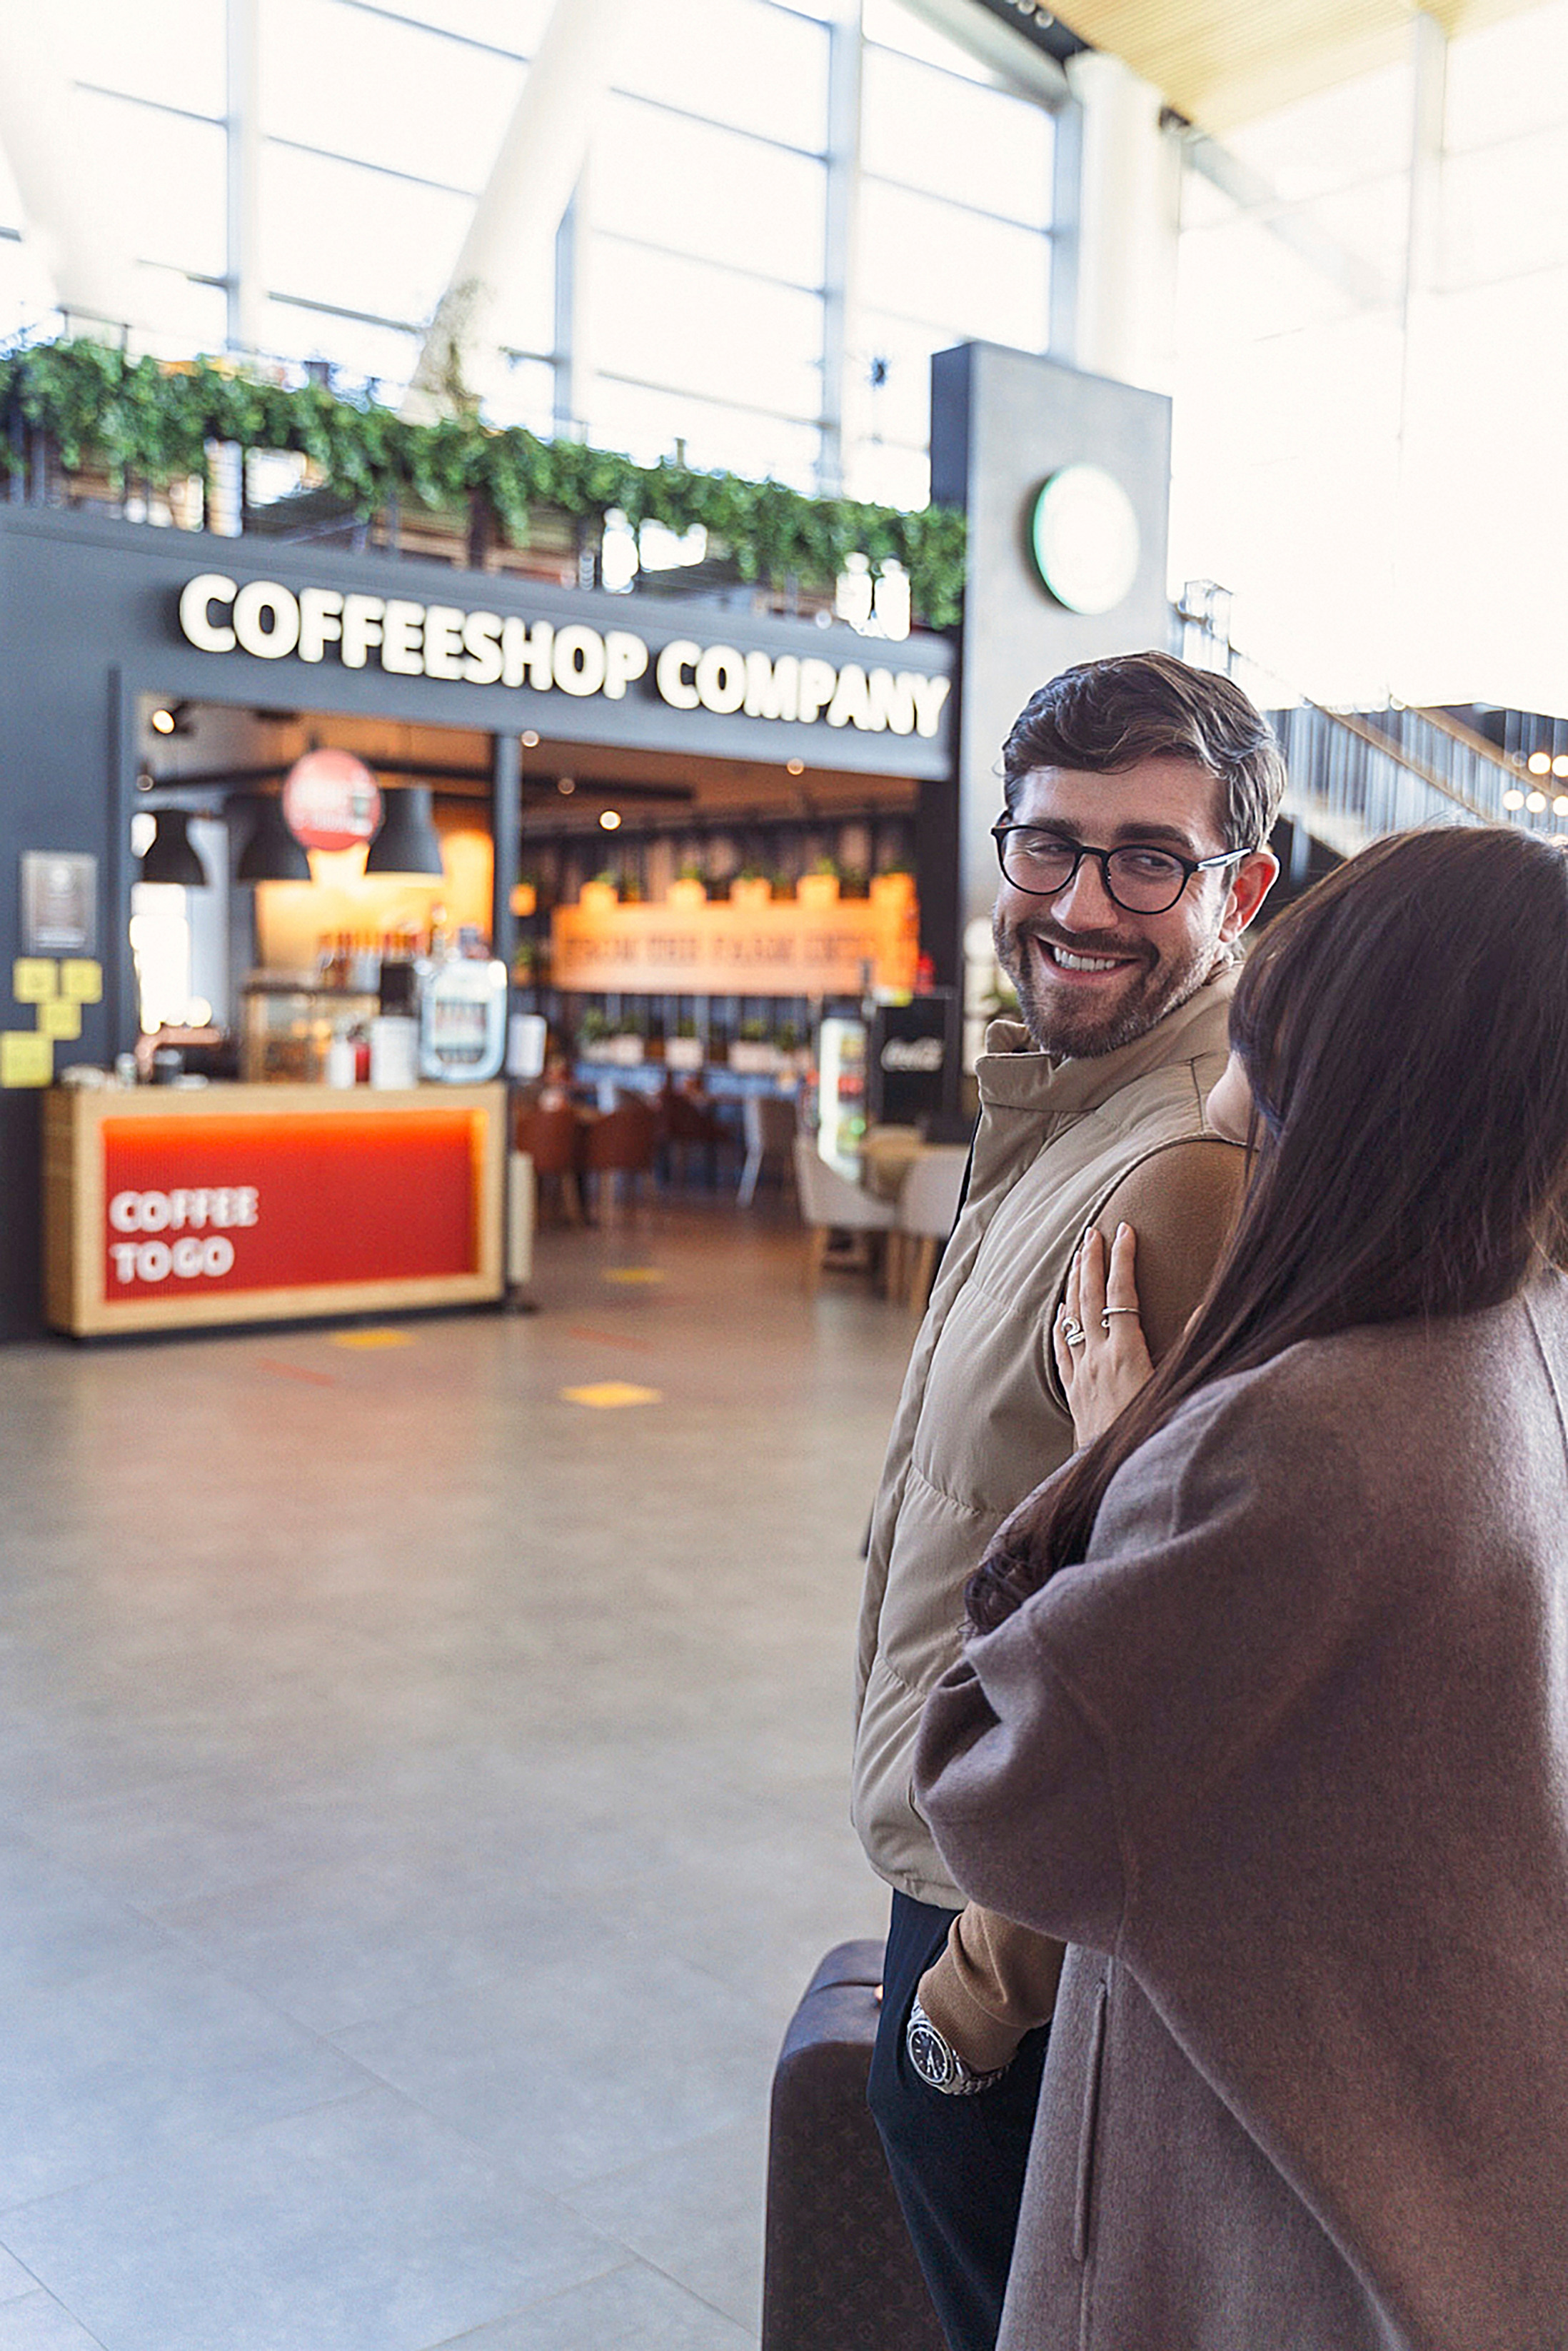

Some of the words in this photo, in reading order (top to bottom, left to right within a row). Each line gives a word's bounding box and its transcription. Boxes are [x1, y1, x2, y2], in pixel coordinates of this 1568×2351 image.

[180, 573, 648, 701] COFFEESHOP
[657, 639, 951, 738] COMPANY
[109, 1186, 259, 1233] COFFEE
